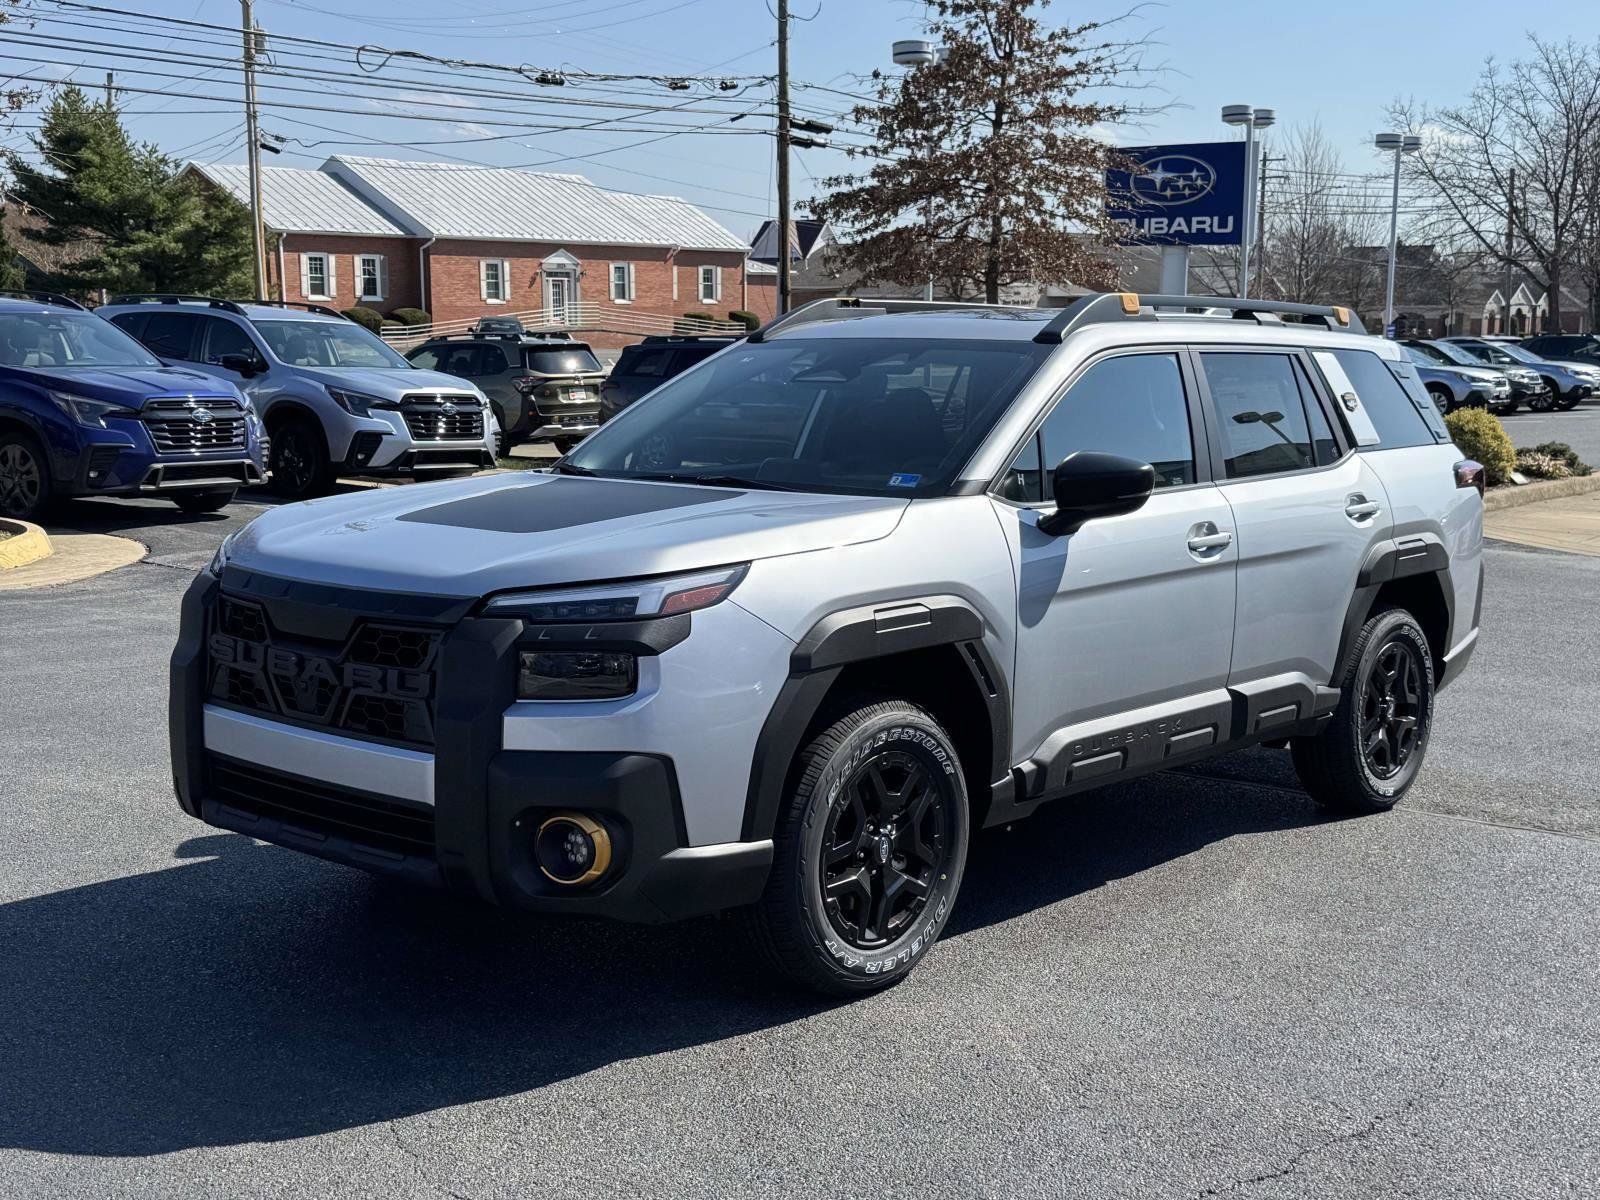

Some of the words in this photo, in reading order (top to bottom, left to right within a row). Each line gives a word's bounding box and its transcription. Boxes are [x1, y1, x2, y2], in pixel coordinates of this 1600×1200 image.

[210, 634, 430, 698] SUBARU
[827, 728, 954, 808] BRIDGESTONE
[1073, 719, 1184, 756] OUTBACK
[825, 939, 861, 968] A/T
[865, 895, 947, 974] DUELER
